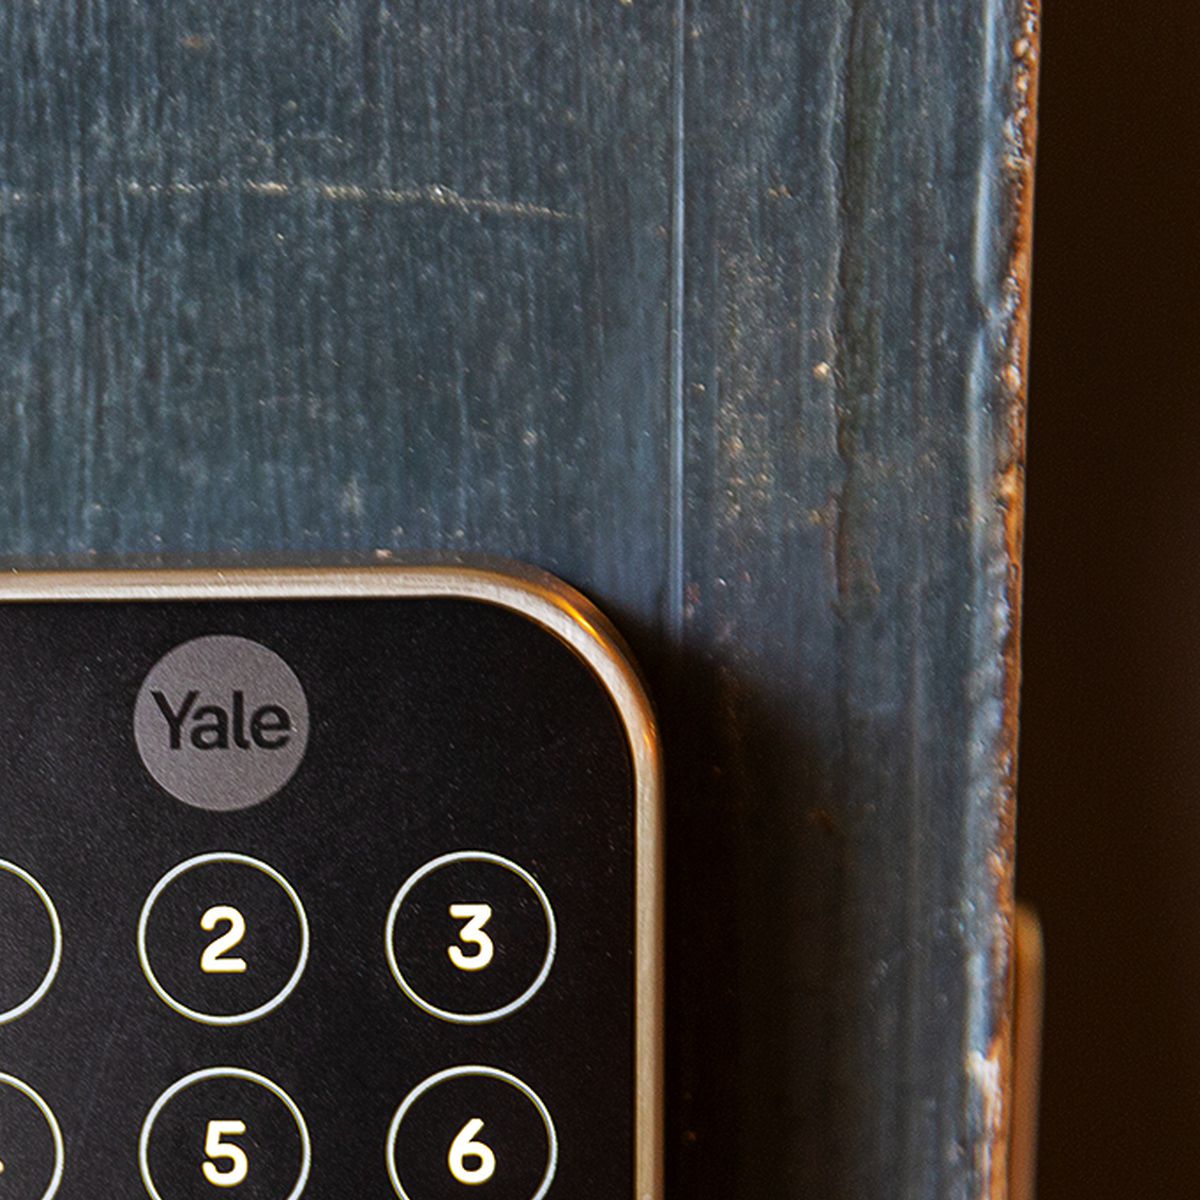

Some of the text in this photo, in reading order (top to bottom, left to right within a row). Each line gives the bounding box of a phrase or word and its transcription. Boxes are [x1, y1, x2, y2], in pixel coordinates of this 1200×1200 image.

[150, 690, 291, 750] Yale
[201, 906, 246, 972] 2
[448, 904, 493, 970] 3
[203, 1121, 247, 1186] 5
[449, 1119, 495, 1184] 6
